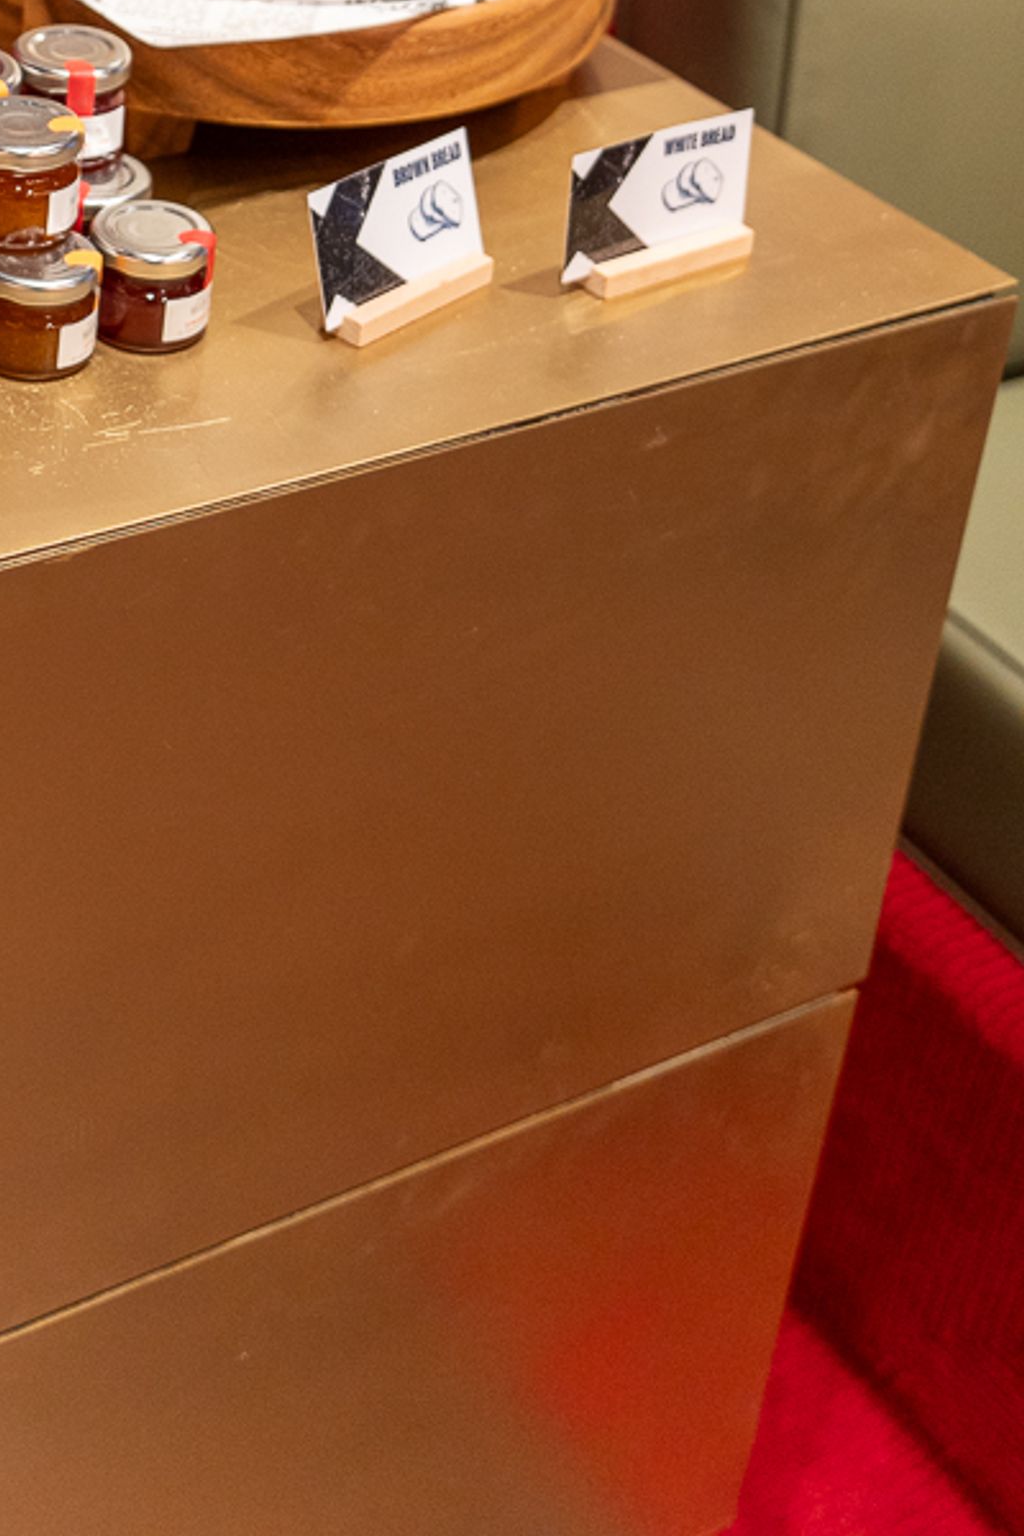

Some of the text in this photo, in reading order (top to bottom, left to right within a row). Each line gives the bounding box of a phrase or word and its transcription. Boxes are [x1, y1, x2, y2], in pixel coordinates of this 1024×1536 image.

[664, 123, 737, 157] WHITE BREAD
[392, 140, 462, 189] BROWN BREAD
